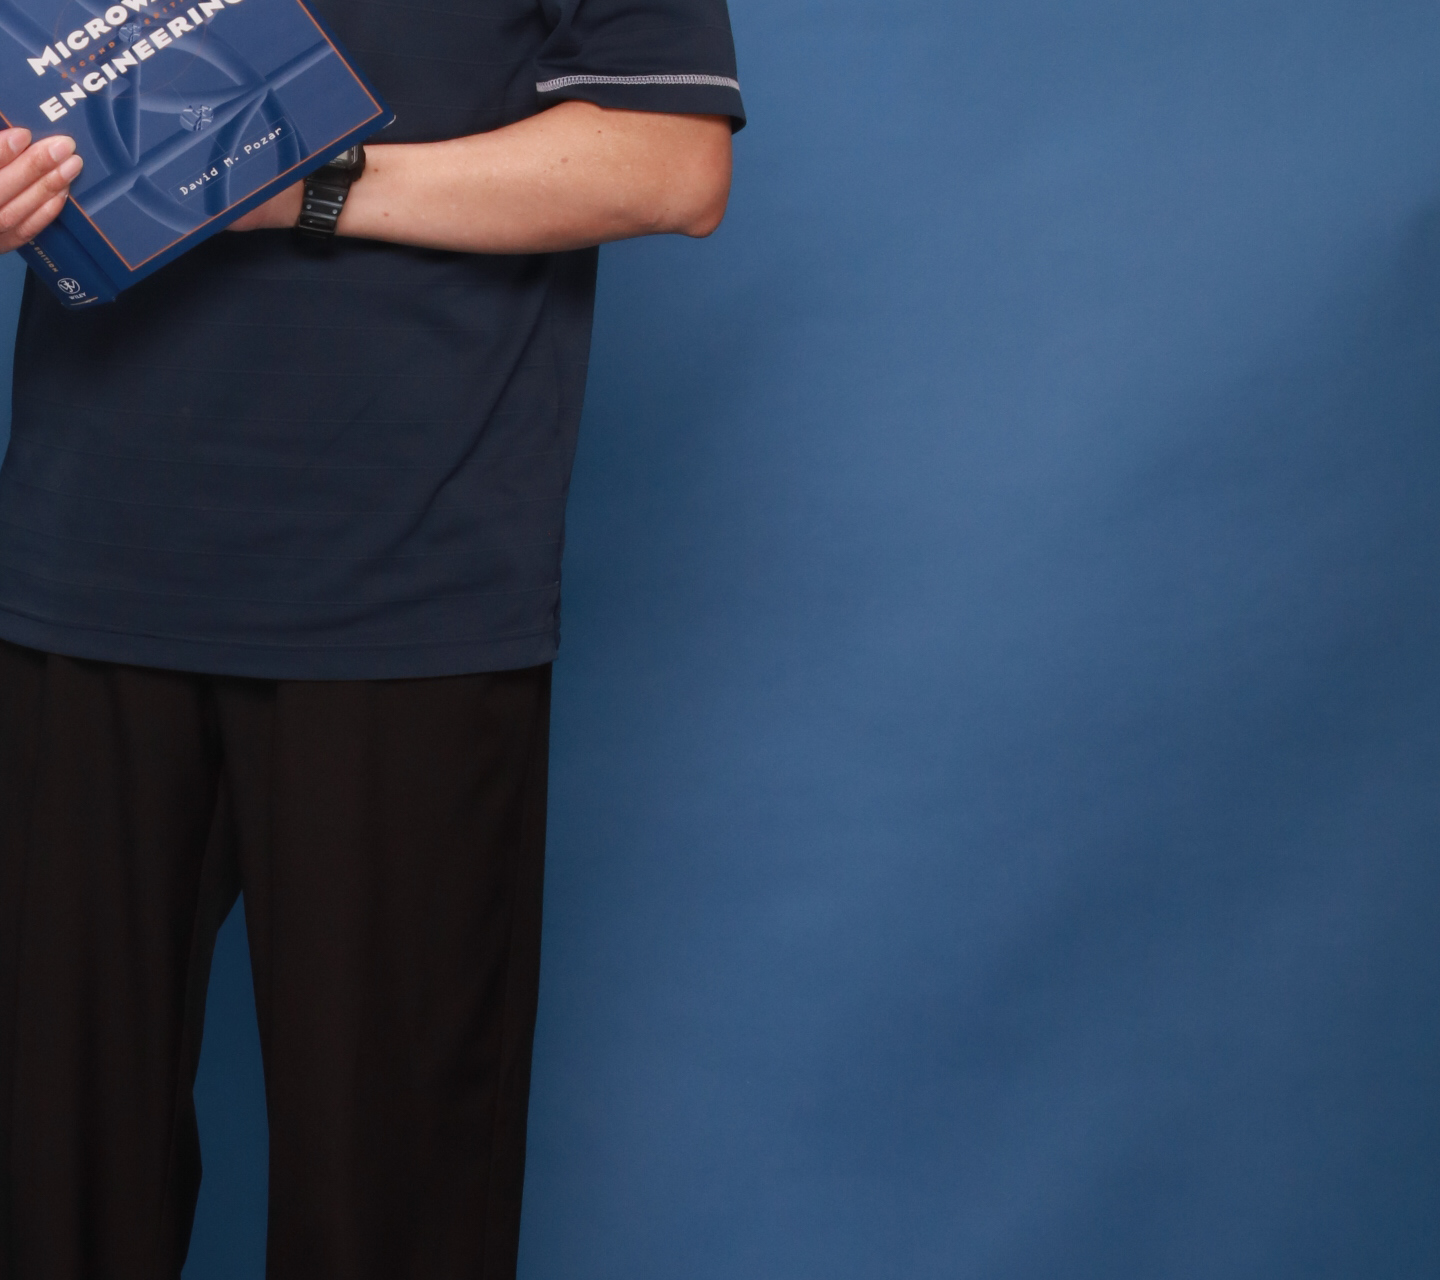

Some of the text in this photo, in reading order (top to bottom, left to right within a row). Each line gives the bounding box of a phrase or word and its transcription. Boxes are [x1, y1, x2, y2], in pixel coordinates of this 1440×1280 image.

[61, 41, 115, 79] SECOND
[180, 127, 282, 195] David M. Pozar
